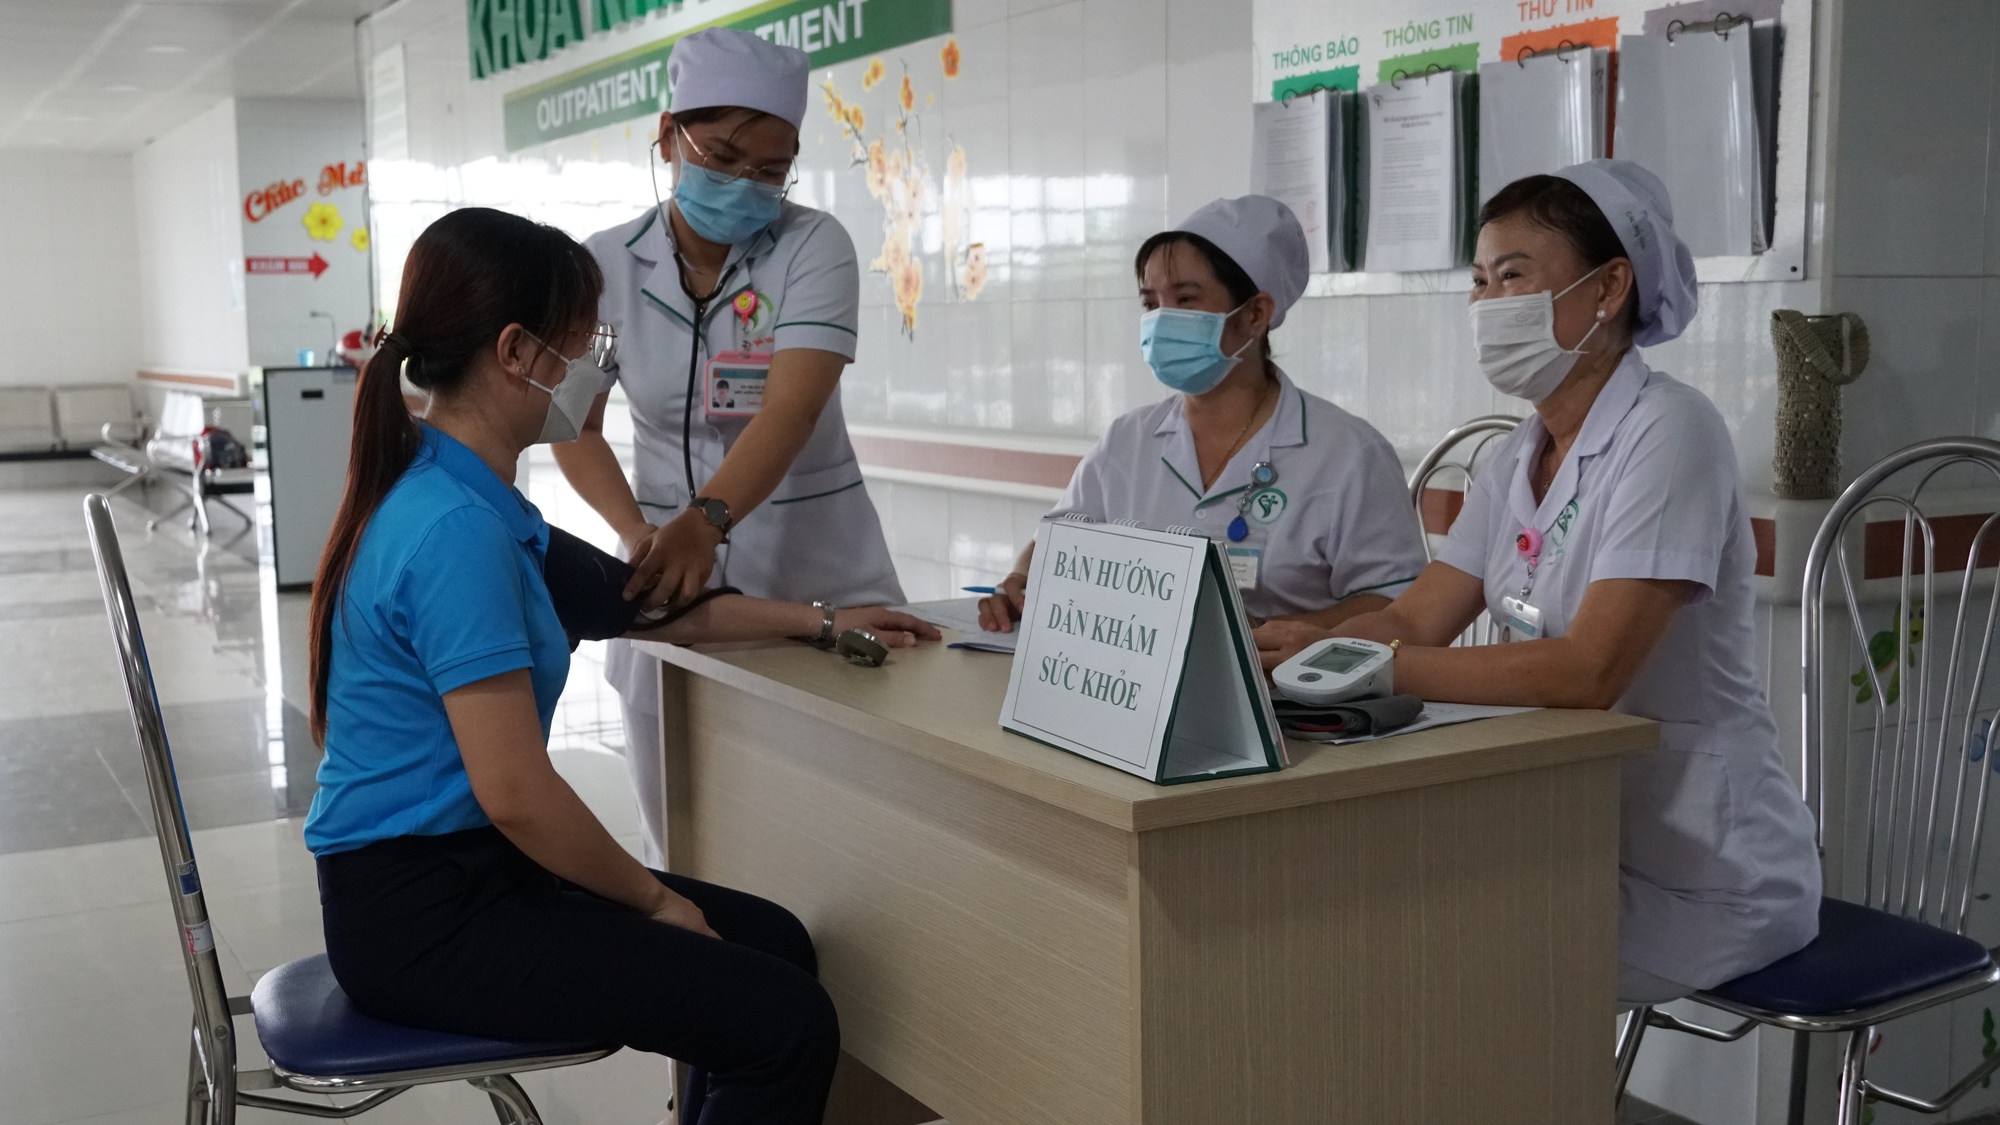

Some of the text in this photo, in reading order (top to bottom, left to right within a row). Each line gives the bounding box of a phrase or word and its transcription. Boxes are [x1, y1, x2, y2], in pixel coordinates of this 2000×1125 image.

[1382, 13, 1474, 48] THÔNG TIN
[1517, 0, 1557, 22] THƯ
[469, 0, 584, 80] KHOA
[1272, 34, 1359, 70] THÔNG BÁO
[537, 61, 662, 130] OUTPATIENT
[1053, 545, 1176, 601] BÀN HƯỚNG
[1047, 598, 1159, 657] DẪN KHÁM
[1038, 651, 1142, 712] SỨC KHỎE
